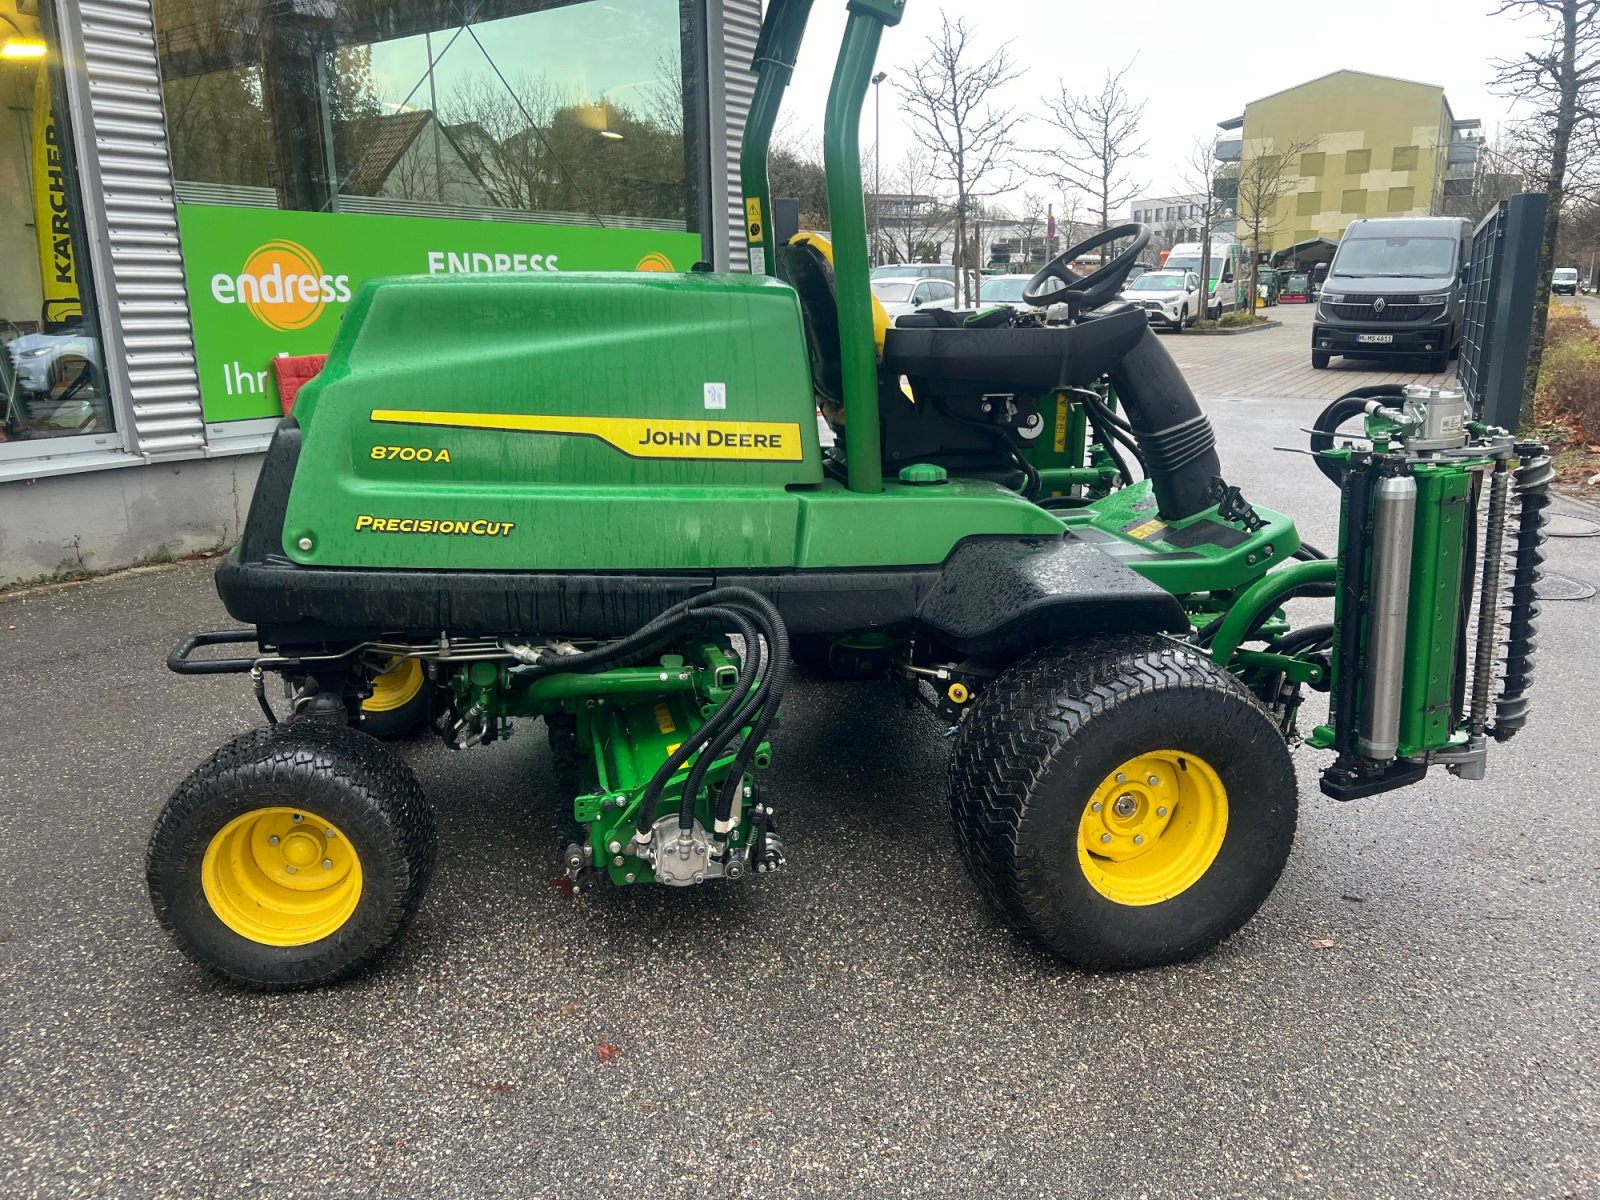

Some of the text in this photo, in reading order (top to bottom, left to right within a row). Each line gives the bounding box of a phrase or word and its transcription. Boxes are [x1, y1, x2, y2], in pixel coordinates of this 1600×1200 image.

[211, 263, 351, 304] endress
[224, 361, 268, 395] Ihr
[638, 428, 782, 448] JOHN DEERE
